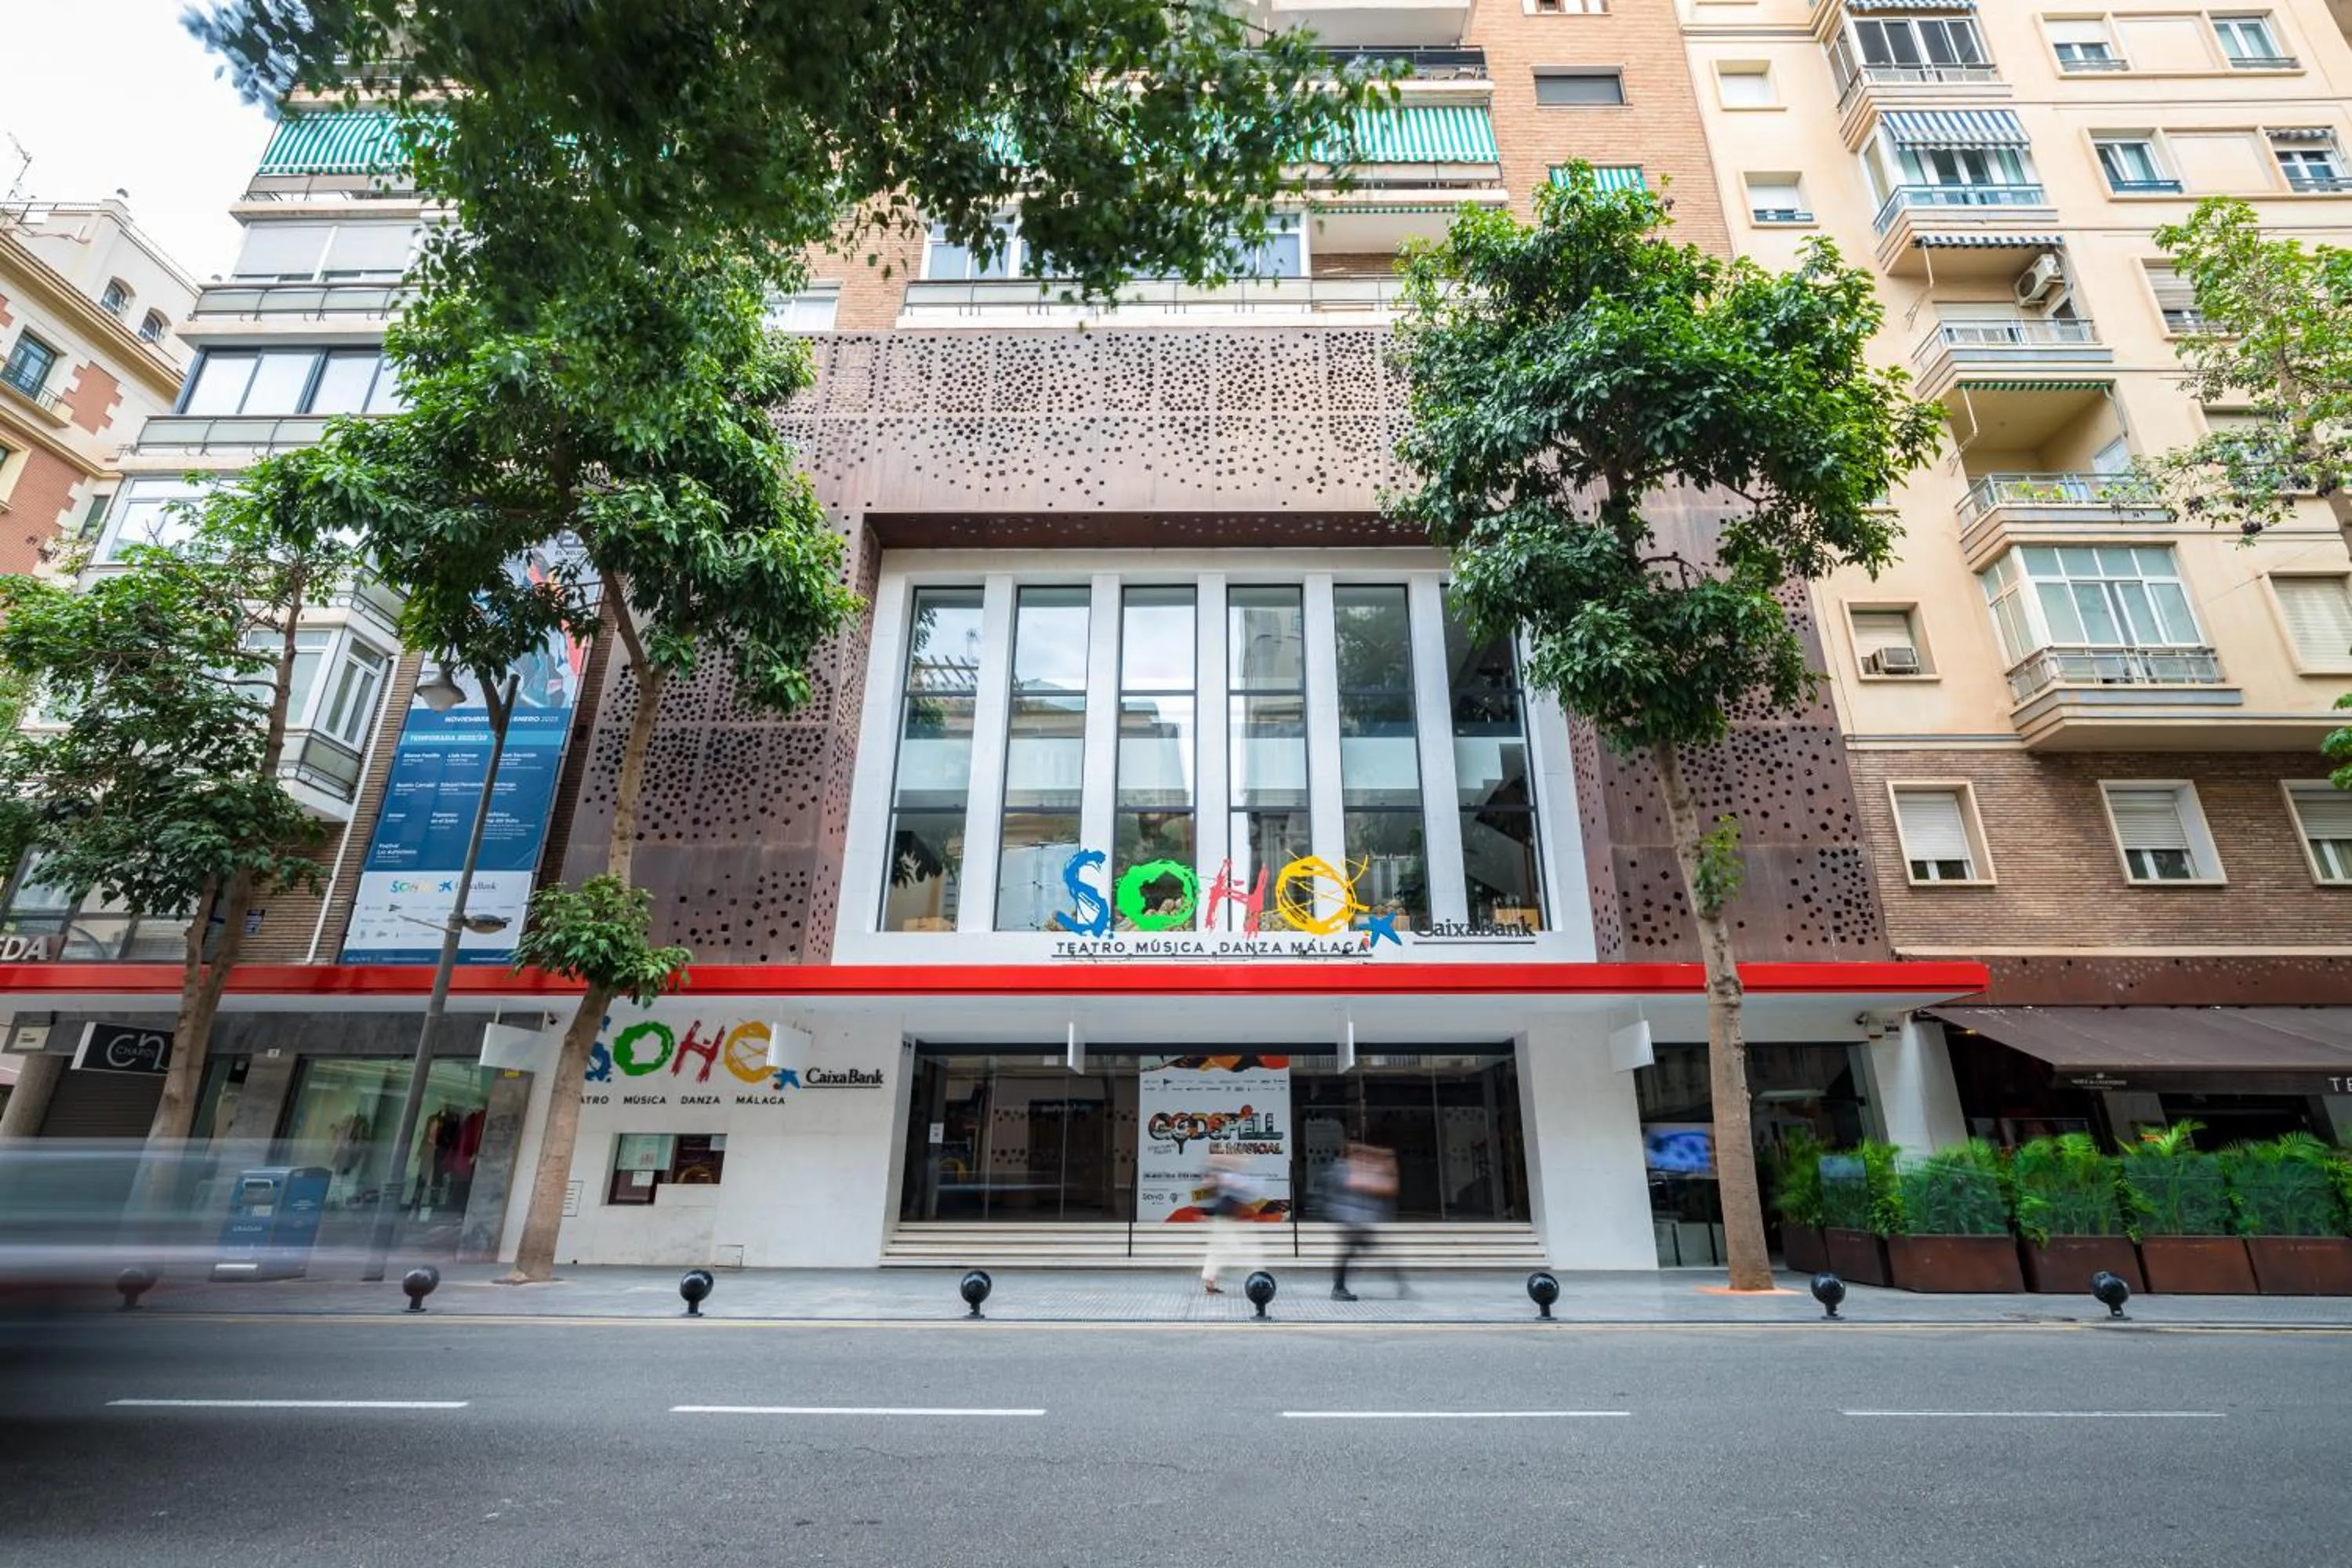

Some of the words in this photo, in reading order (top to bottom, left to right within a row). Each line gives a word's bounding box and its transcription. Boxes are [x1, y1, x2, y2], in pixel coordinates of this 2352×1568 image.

[1052, 848, 1370, 939] SOHO
[1412, 915, 1536, 938] CaixaBank
[1057, 942, 1126, 954] TEATRO
[1135, 938, 1205, 954] MÚSICA
[1220, 942, 1283, 954] DANZA
[1290, 938, 1370, 954] MÁLAGA
[805, 1067, 884, 1085] CaixaBank
[622, 1093, 666, 1105] MÚSICA
[680, 1094, 720, 1105] DANZA
[735, 1093, 786, 1105] MÁLAGA
